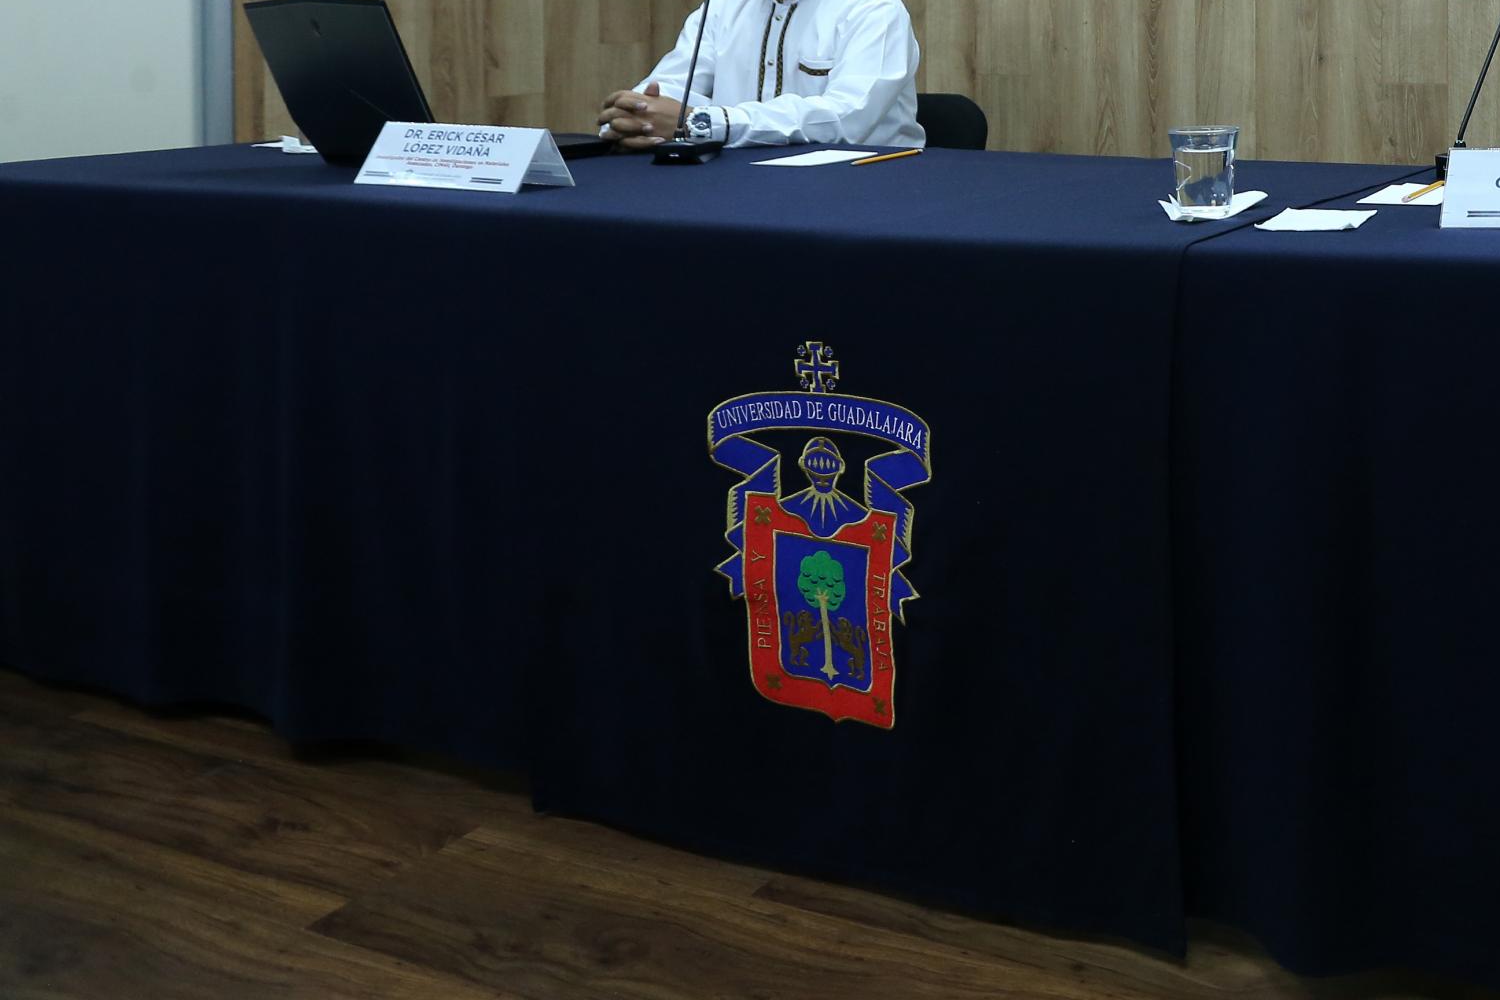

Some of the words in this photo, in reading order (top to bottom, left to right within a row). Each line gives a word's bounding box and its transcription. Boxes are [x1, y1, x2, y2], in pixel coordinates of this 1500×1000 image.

[404, 128, 423, 140] DR.
[427, 130, 464, 142] ERICK
[465, 130, 505, 144] CÉSAR
[403, 140, 442, 154] LÓPEZ
[446, 143, 490, 157] VIDAÑA
[716, 400, 802, 429] UNIVERSIDAD
[806, 400, 824, 420] DE
[828, 403, 922, 449] GUADALAJARA
[751, 549, 767, 562] Y
